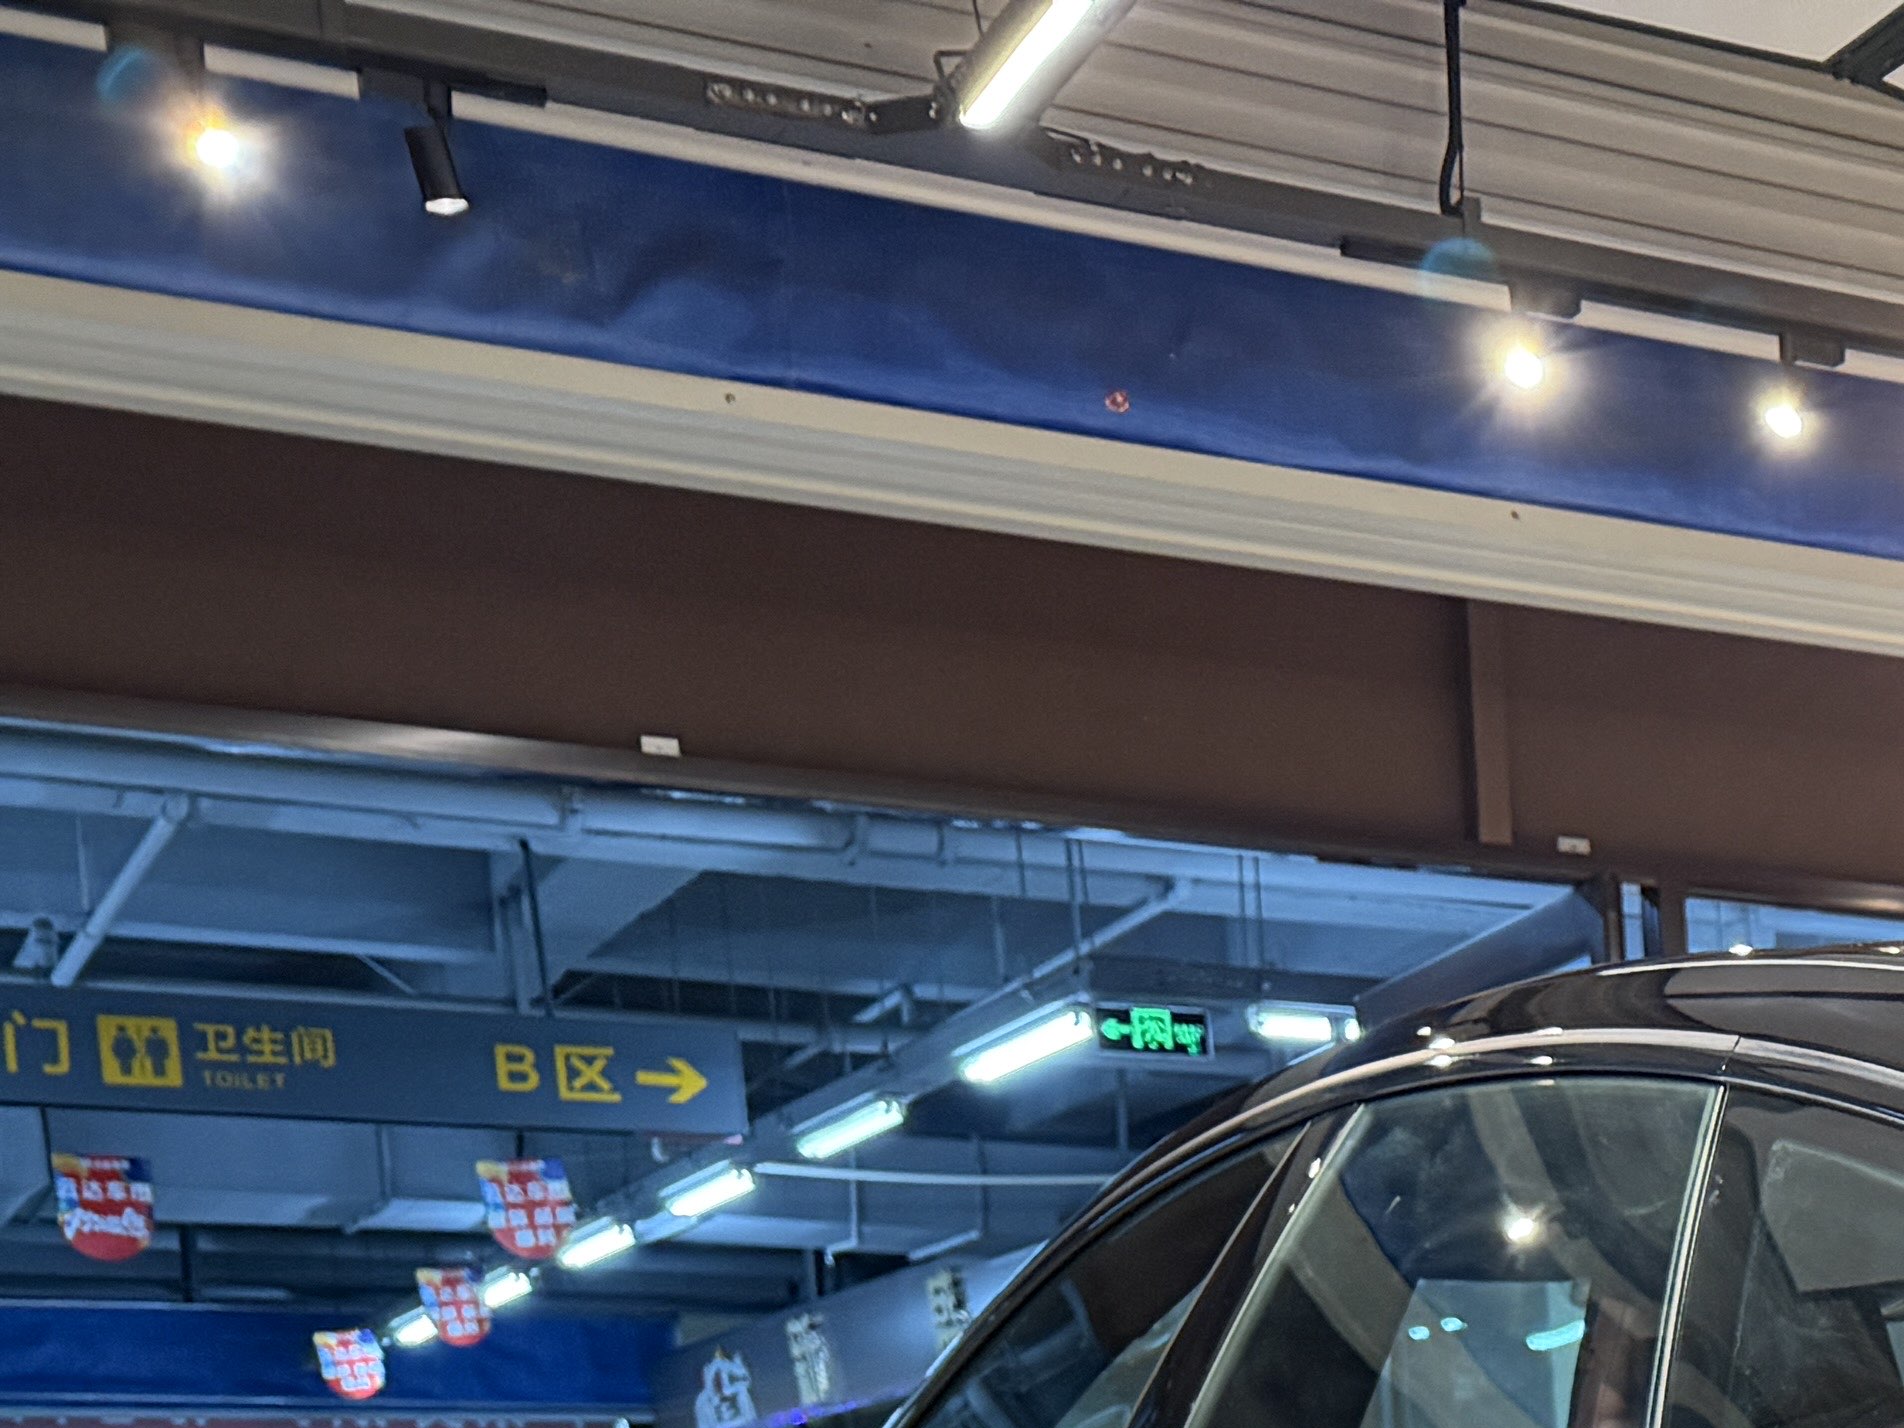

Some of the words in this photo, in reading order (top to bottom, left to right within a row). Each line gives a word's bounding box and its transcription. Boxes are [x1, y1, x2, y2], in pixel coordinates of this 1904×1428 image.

[193, 1023, 337, 1070] 卫生间
[494, 1043, 623, 1104] B区
[204, 1069, 286, 1091] TOILET
